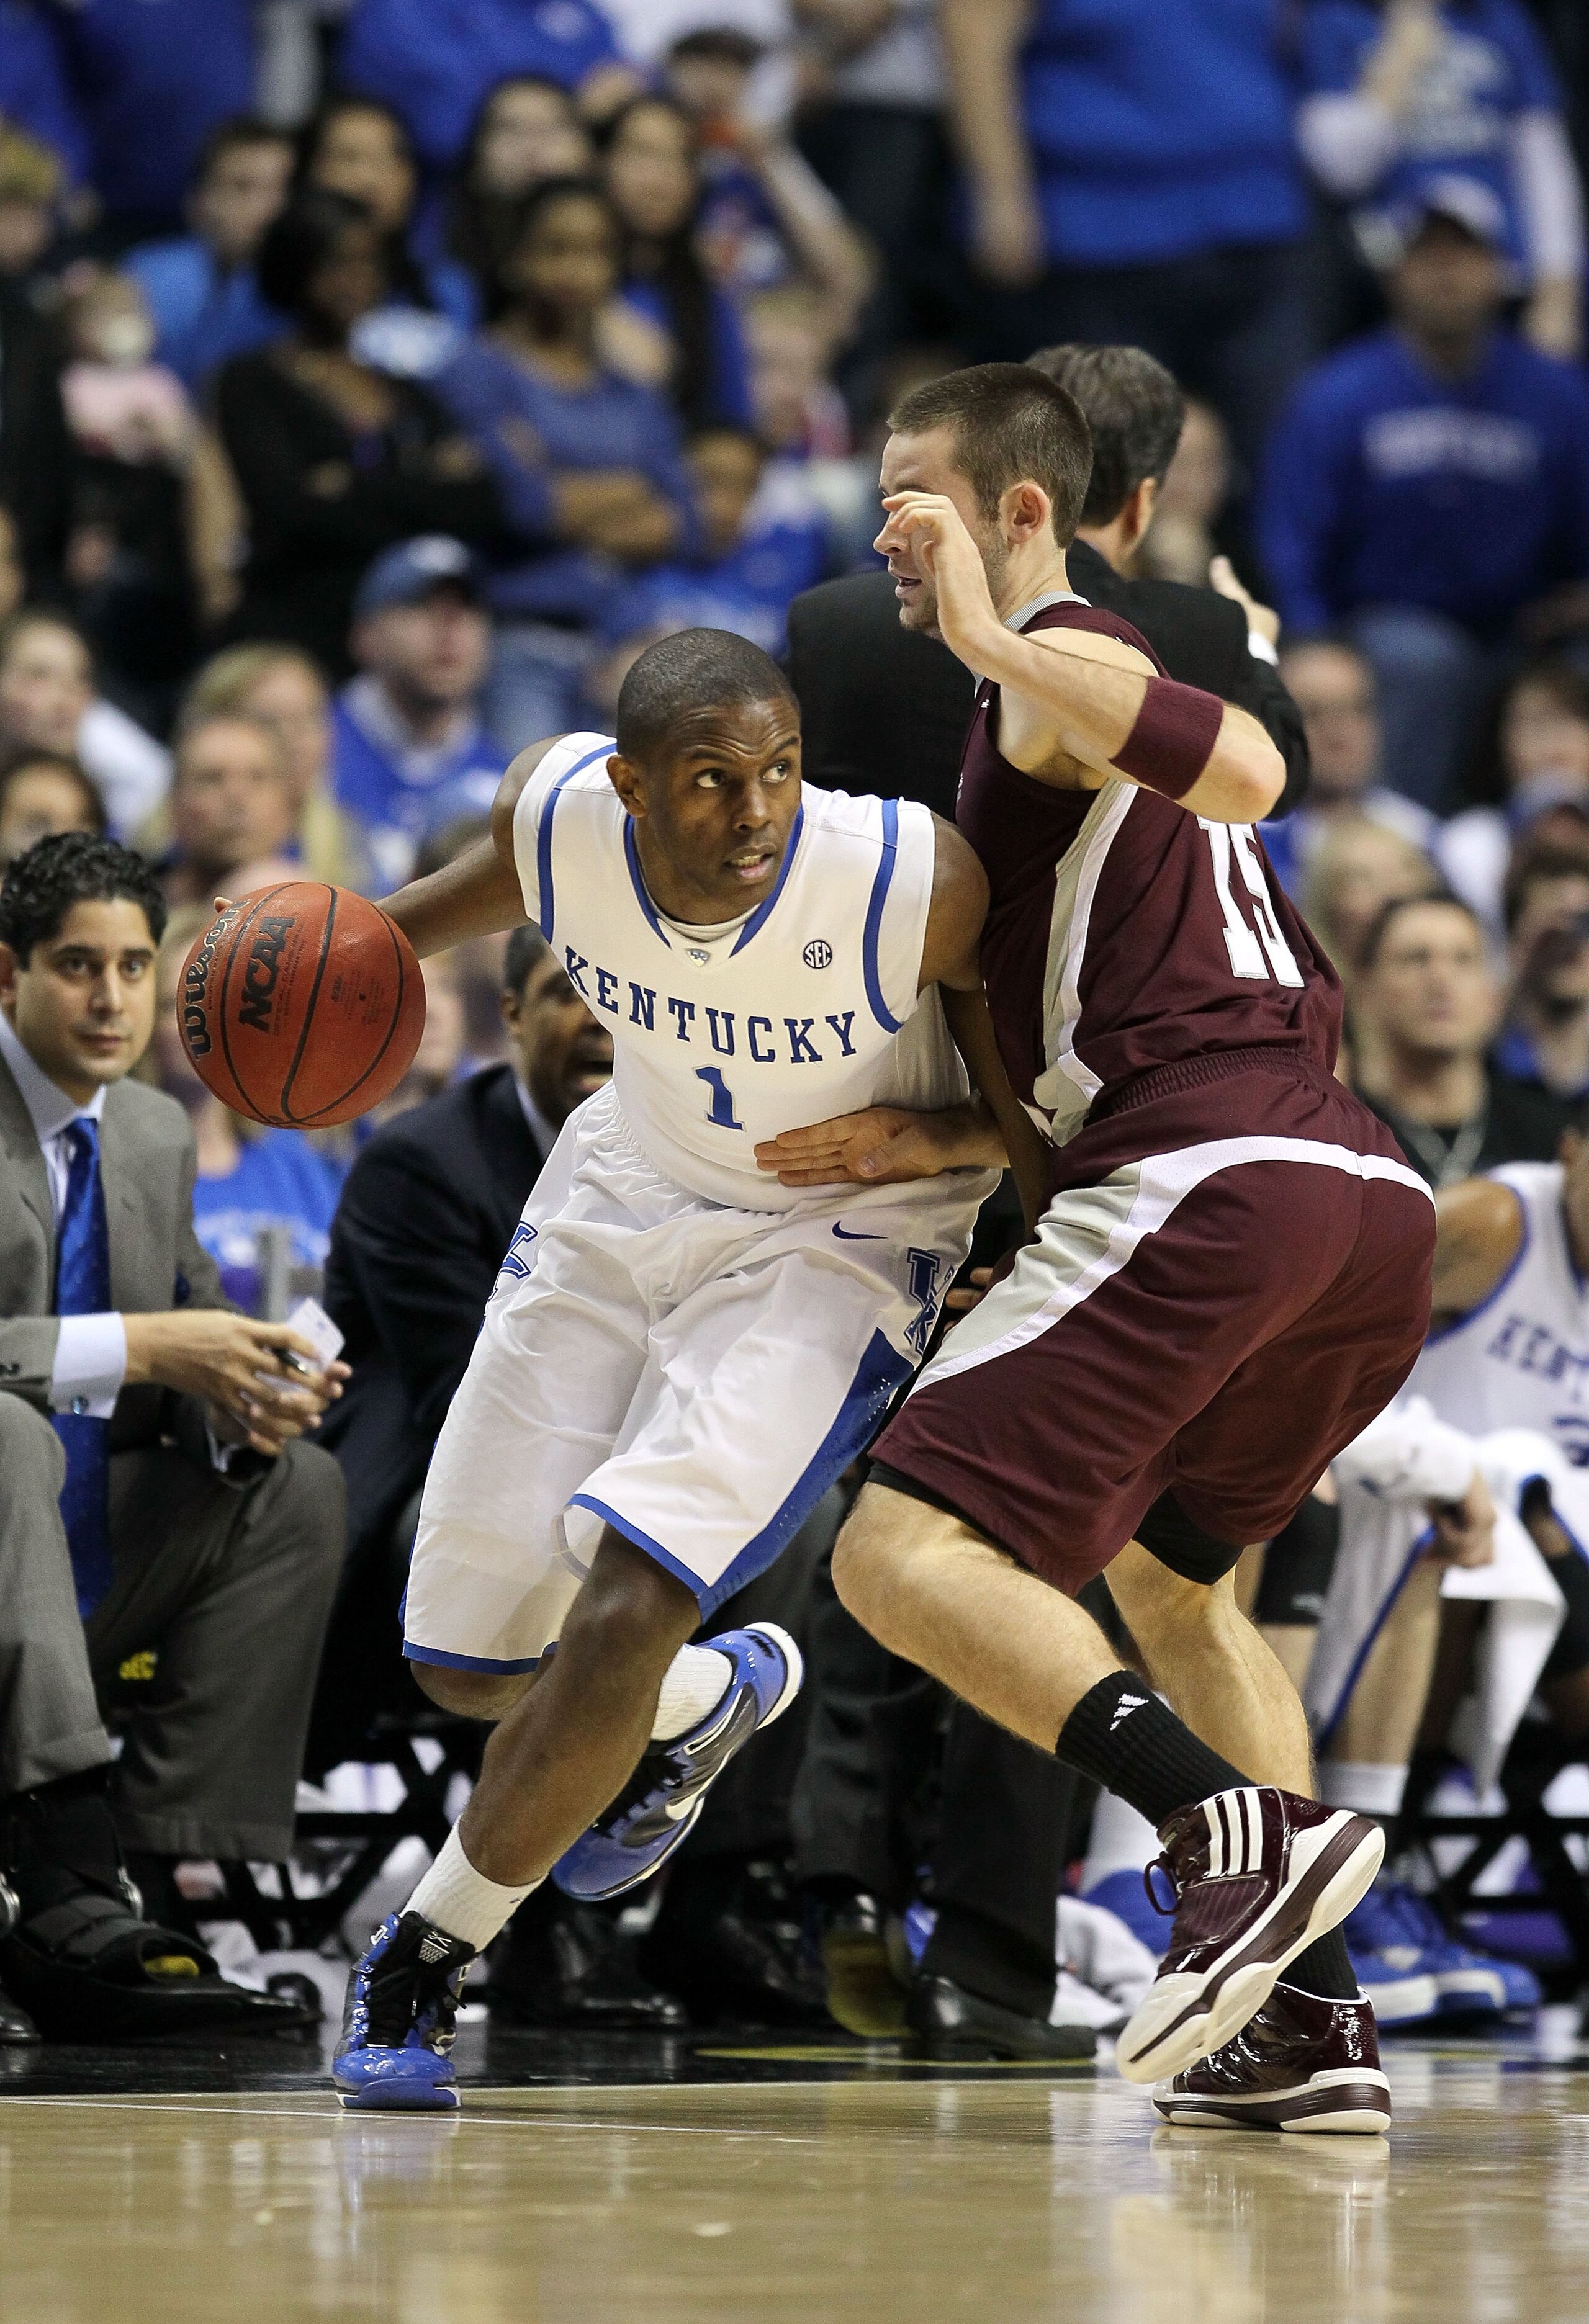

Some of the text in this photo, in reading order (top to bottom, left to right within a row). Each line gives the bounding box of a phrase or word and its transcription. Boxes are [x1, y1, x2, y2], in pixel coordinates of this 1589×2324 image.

[805, 942, 831, 967] SEC
[1197, 815, 1304, 987] 15
[184, 899, 252, 1061] Wilson
[238, 917, 296, 1034] NCAA
[565, 945, 857, 1063] KENTUCKY
[693, 1064, 745, 1131] 1
